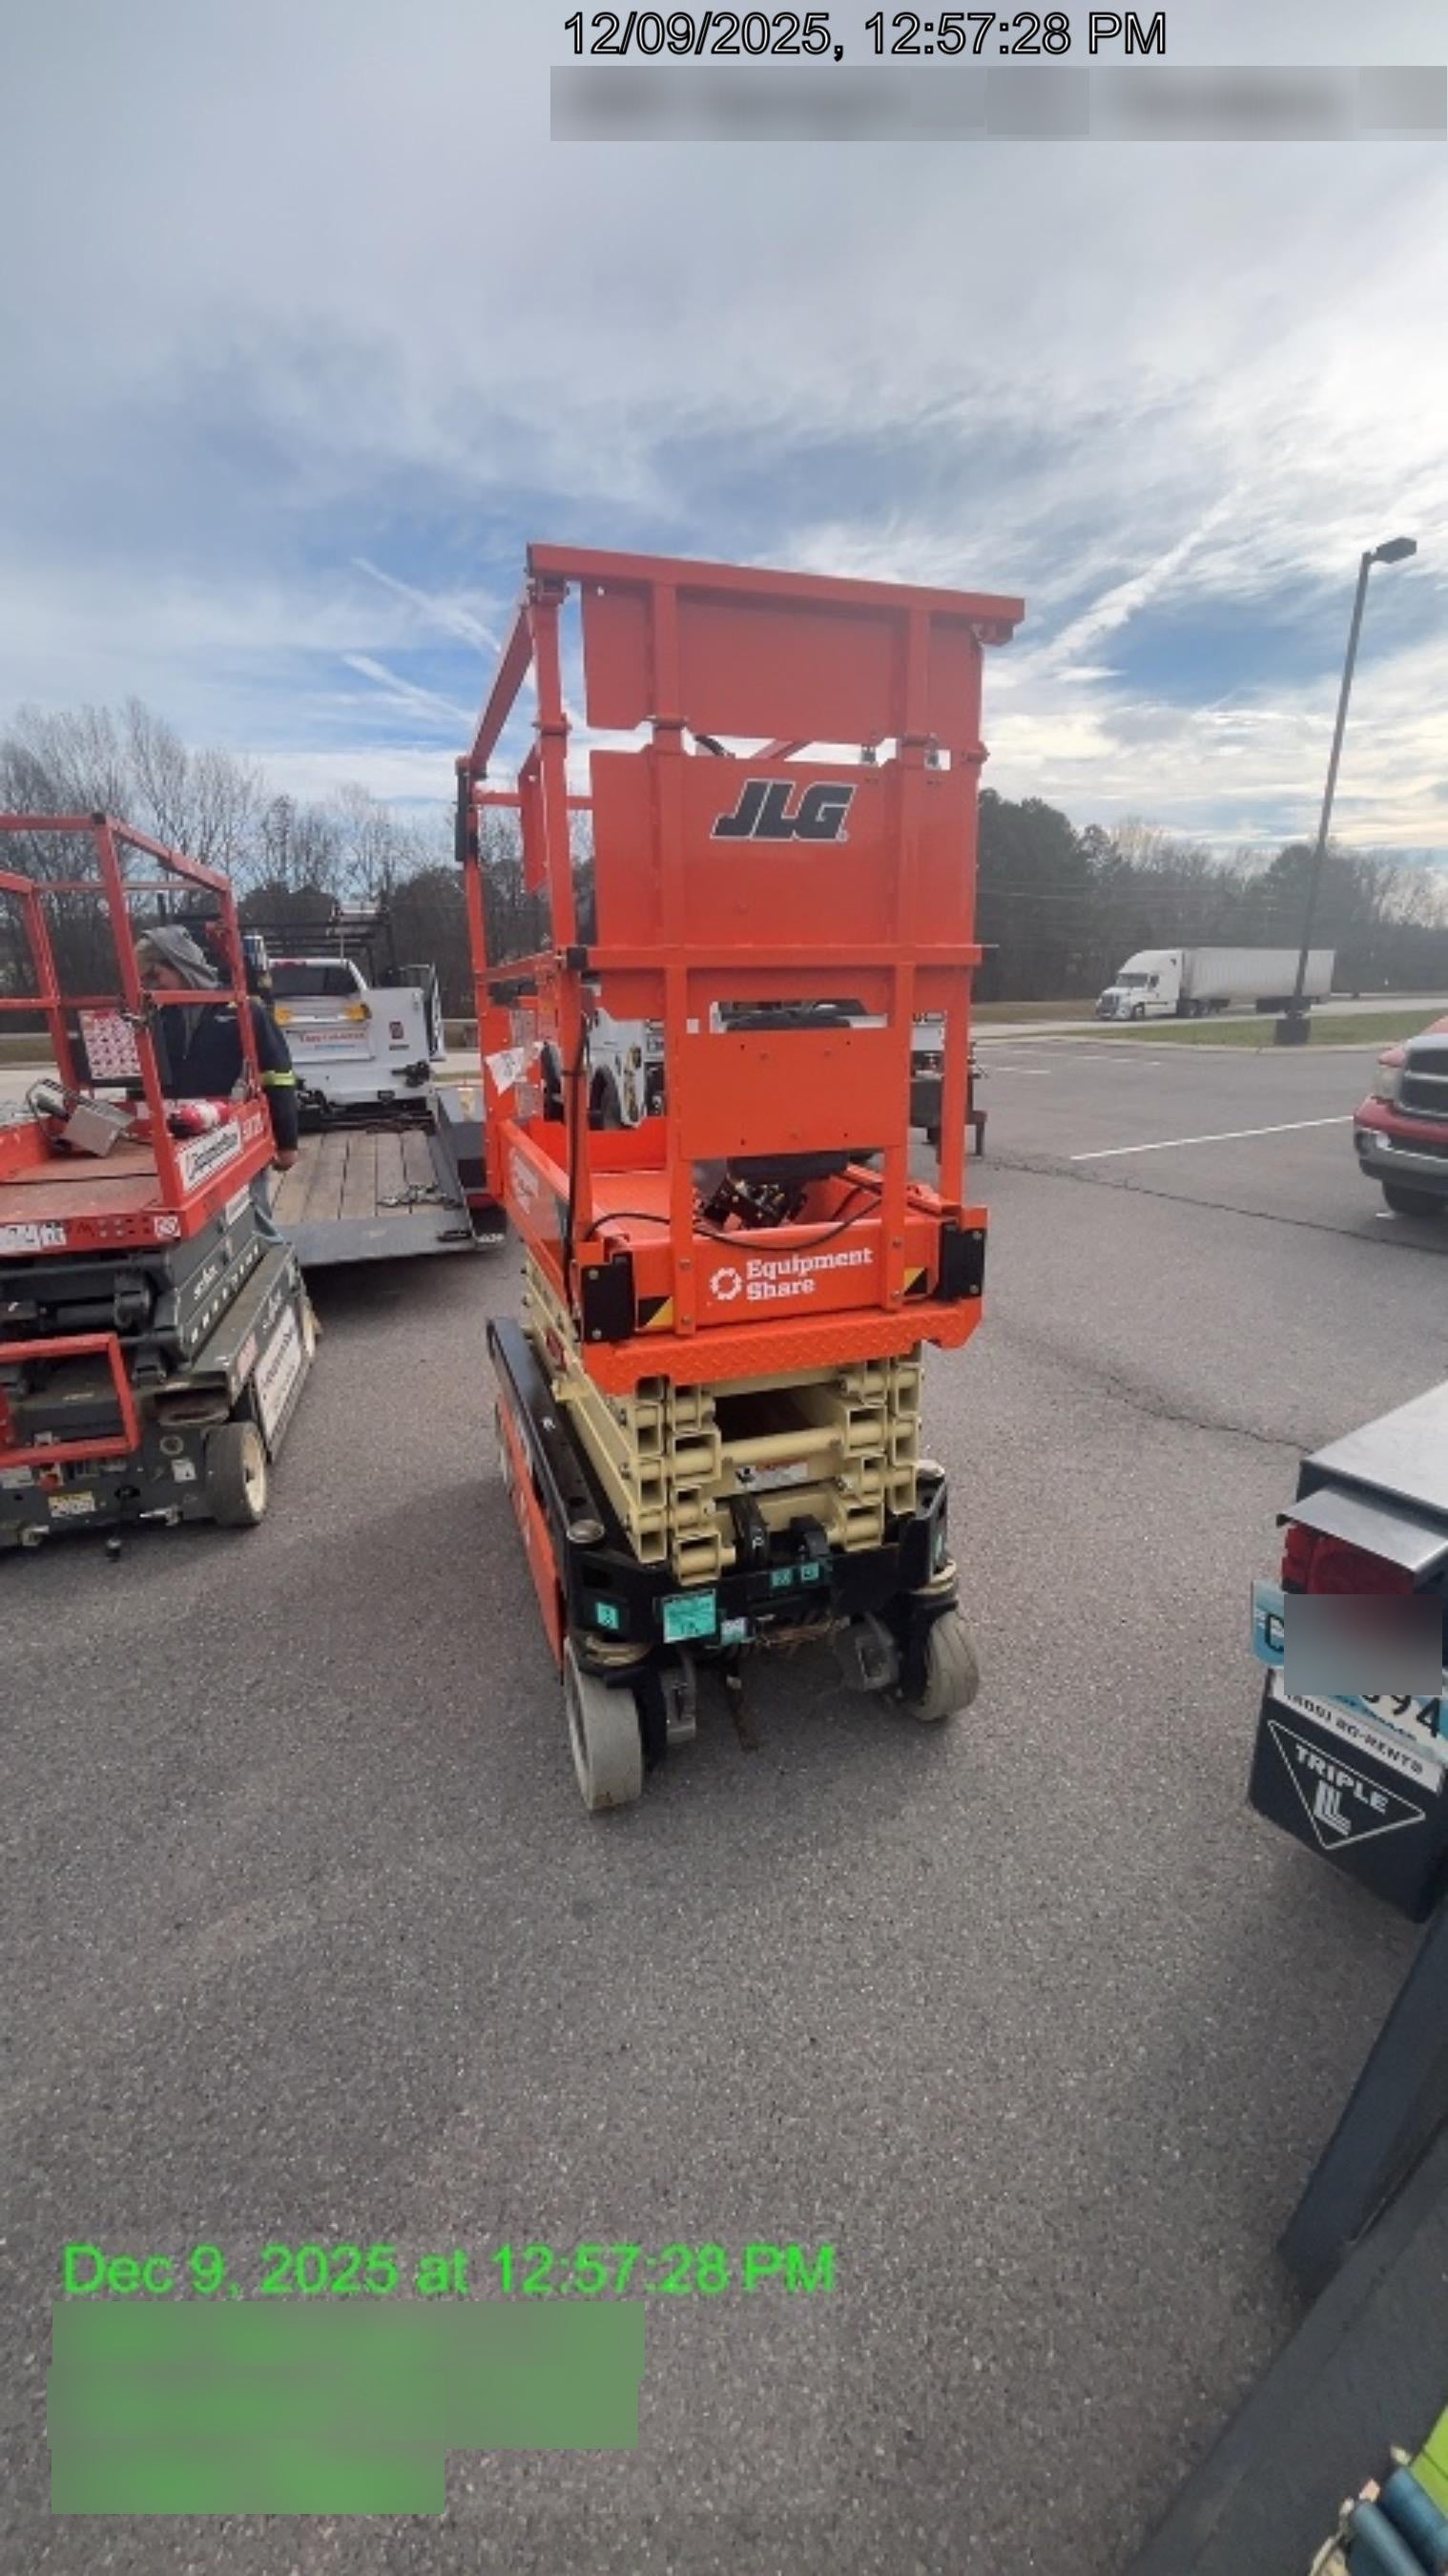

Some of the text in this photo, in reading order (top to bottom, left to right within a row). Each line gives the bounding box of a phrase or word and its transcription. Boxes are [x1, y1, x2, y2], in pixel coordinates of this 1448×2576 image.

[710, 778, 857, 842] JLG
[746, 1248, 873, 1280] Equipment
[746, 1278, 815, 1301] Share
[1295, 1742, 1390, 1814] TRIPLE
